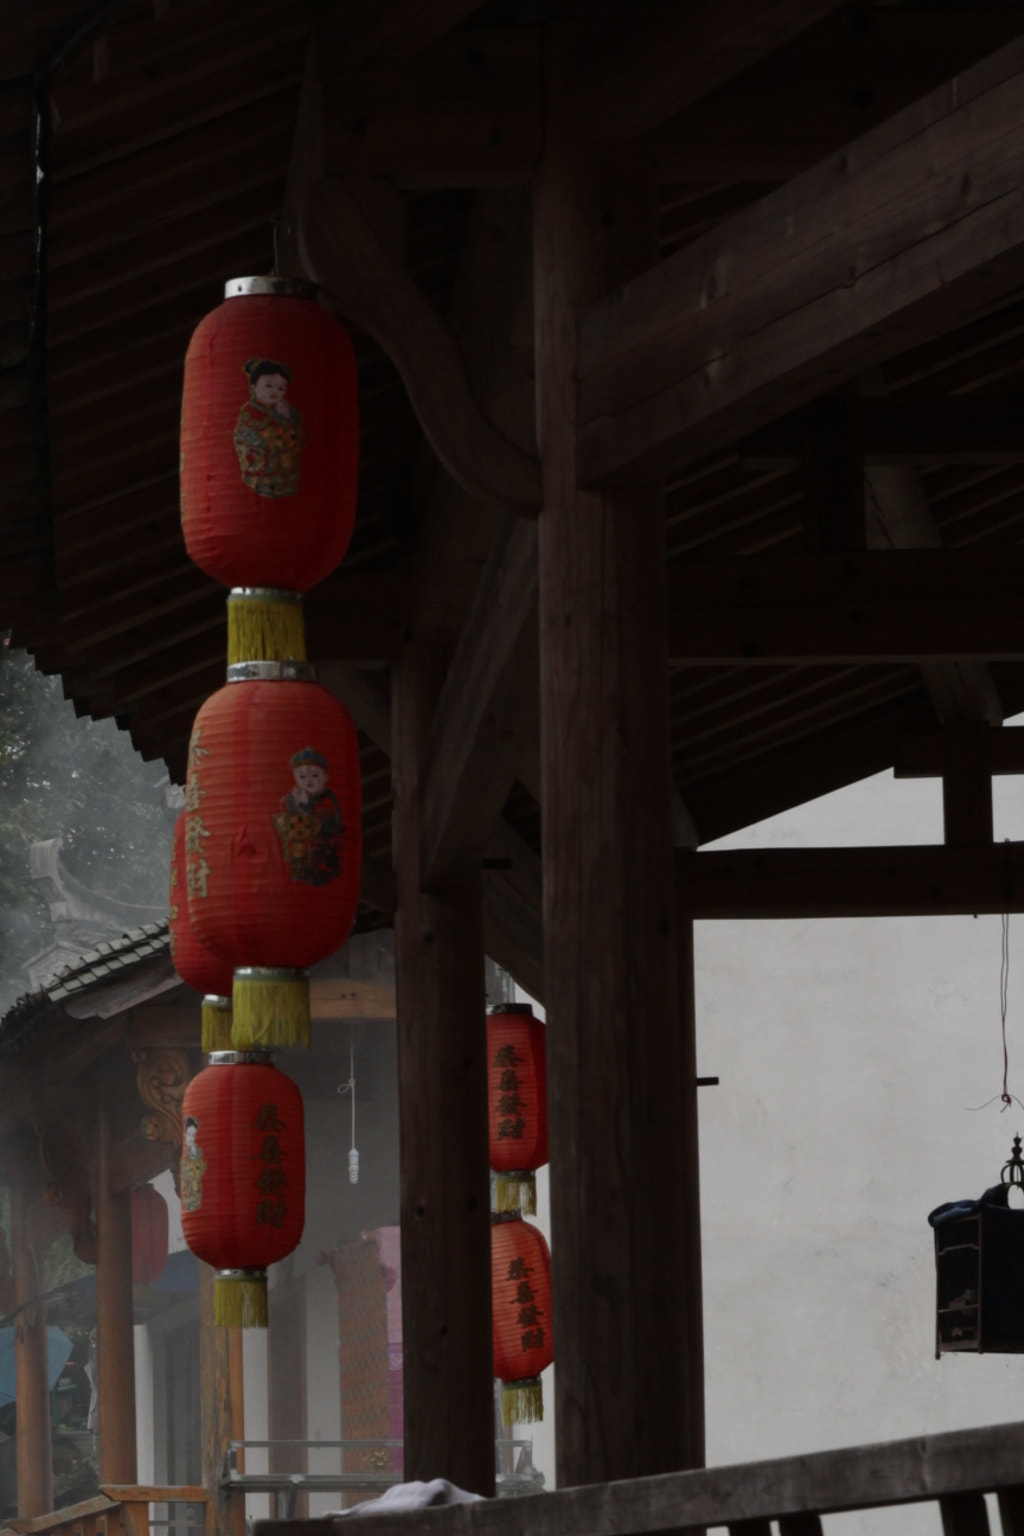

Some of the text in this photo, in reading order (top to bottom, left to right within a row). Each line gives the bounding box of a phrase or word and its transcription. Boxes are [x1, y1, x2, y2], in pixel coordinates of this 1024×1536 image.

[493, 1044, 528, 1140] 恭喜發財
[249, 1103, 288, 1229] 恭喜發財
[505, 1256, 546, 1353] 恭喜發財
